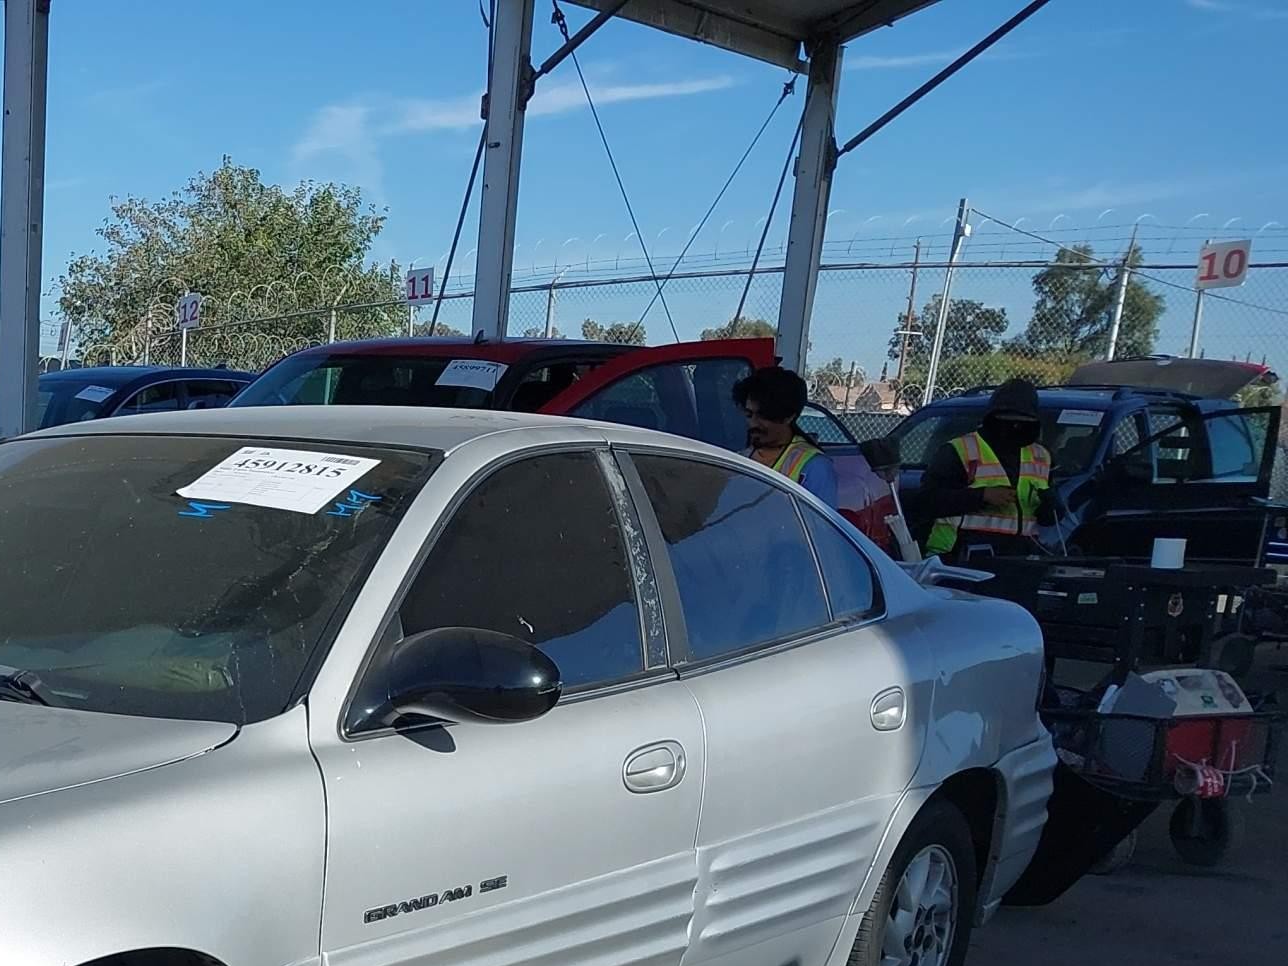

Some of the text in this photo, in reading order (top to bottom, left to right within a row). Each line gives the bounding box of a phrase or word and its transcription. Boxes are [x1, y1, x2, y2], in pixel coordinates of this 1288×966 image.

[1199, 249, 1246, 281] 10
[407, 274, 432, 300] 11
[180, 300, 199, 324] 12
[233, 457, 349, 479] 45912815
[363, 875, 508, 924] GRAND AM SE
